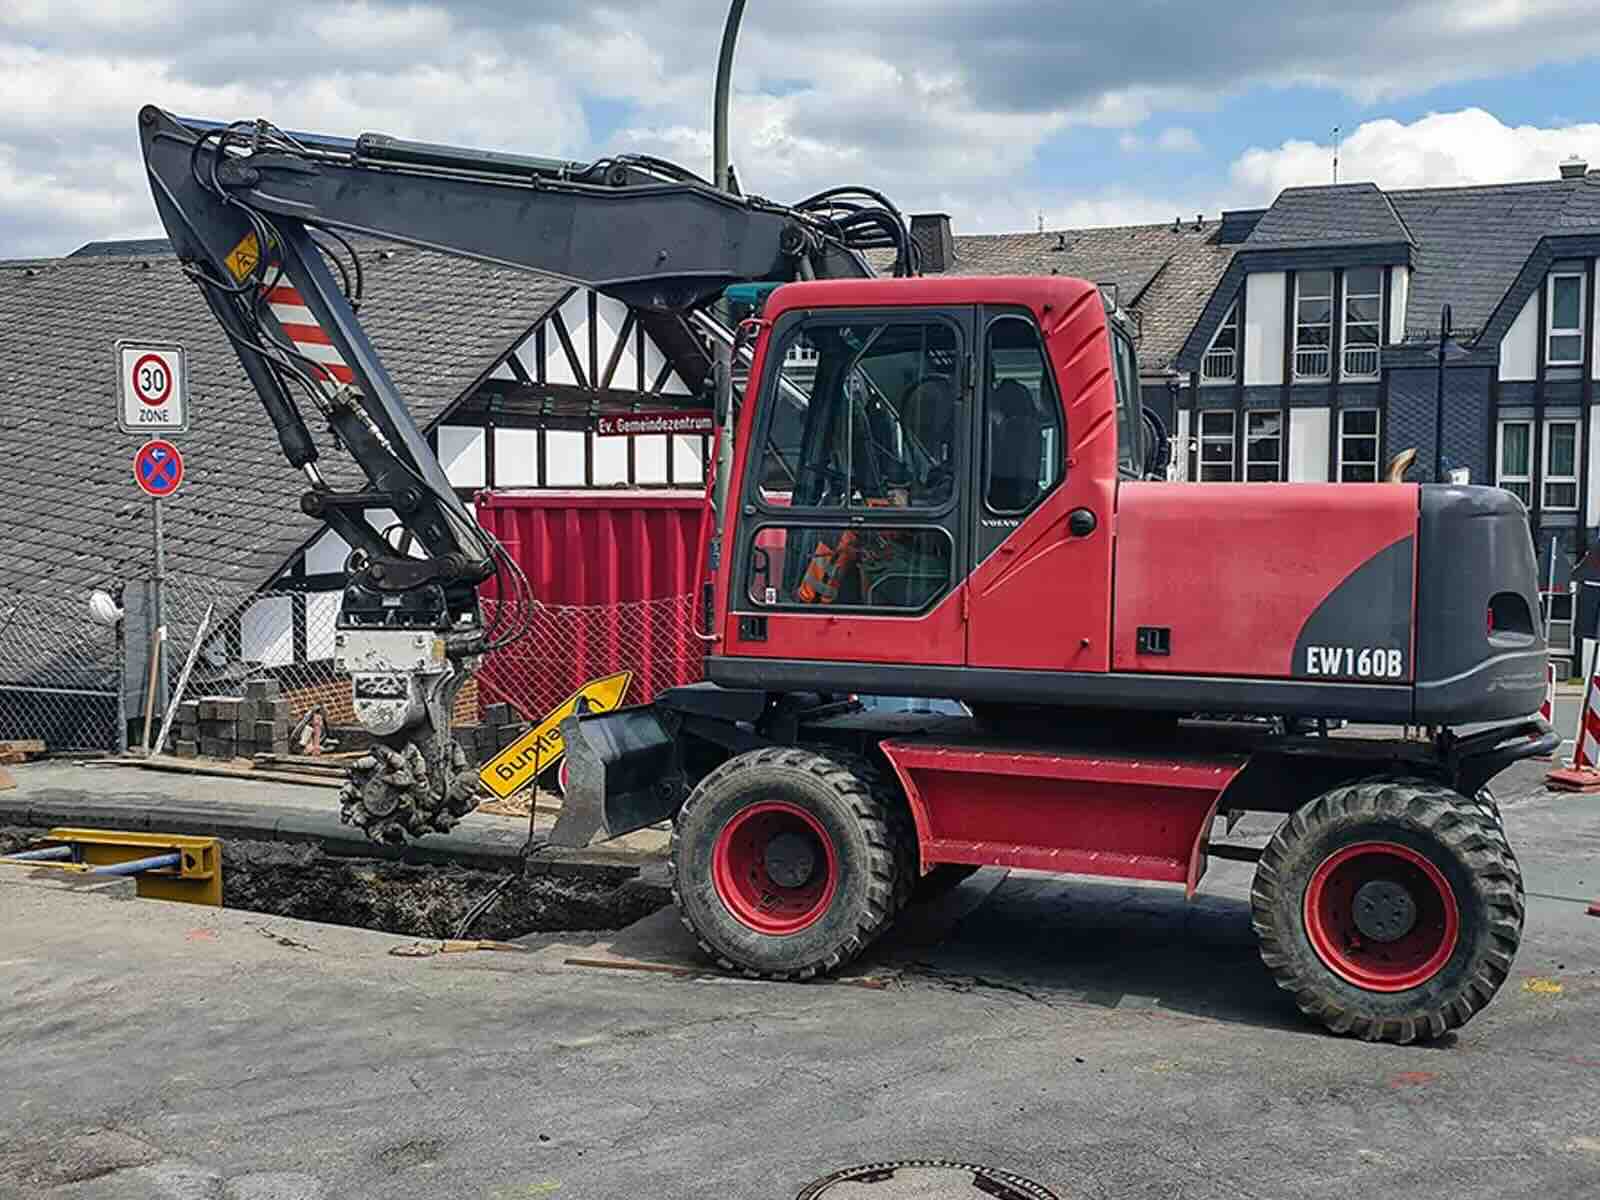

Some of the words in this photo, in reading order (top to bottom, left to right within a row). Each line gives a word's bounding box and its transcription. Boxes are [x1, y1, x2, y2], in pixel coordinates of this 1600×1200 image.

[140, 368, 165, 392] 30
[138, 409, 169, 422] ZONE
[598, 418, 614, 433] Ev.
[616, 416, 713, 432] Gemeindezentrum
[981, 519, 1018, 527] VOLVO
[1306, 646, 1402, 677] EW160B
